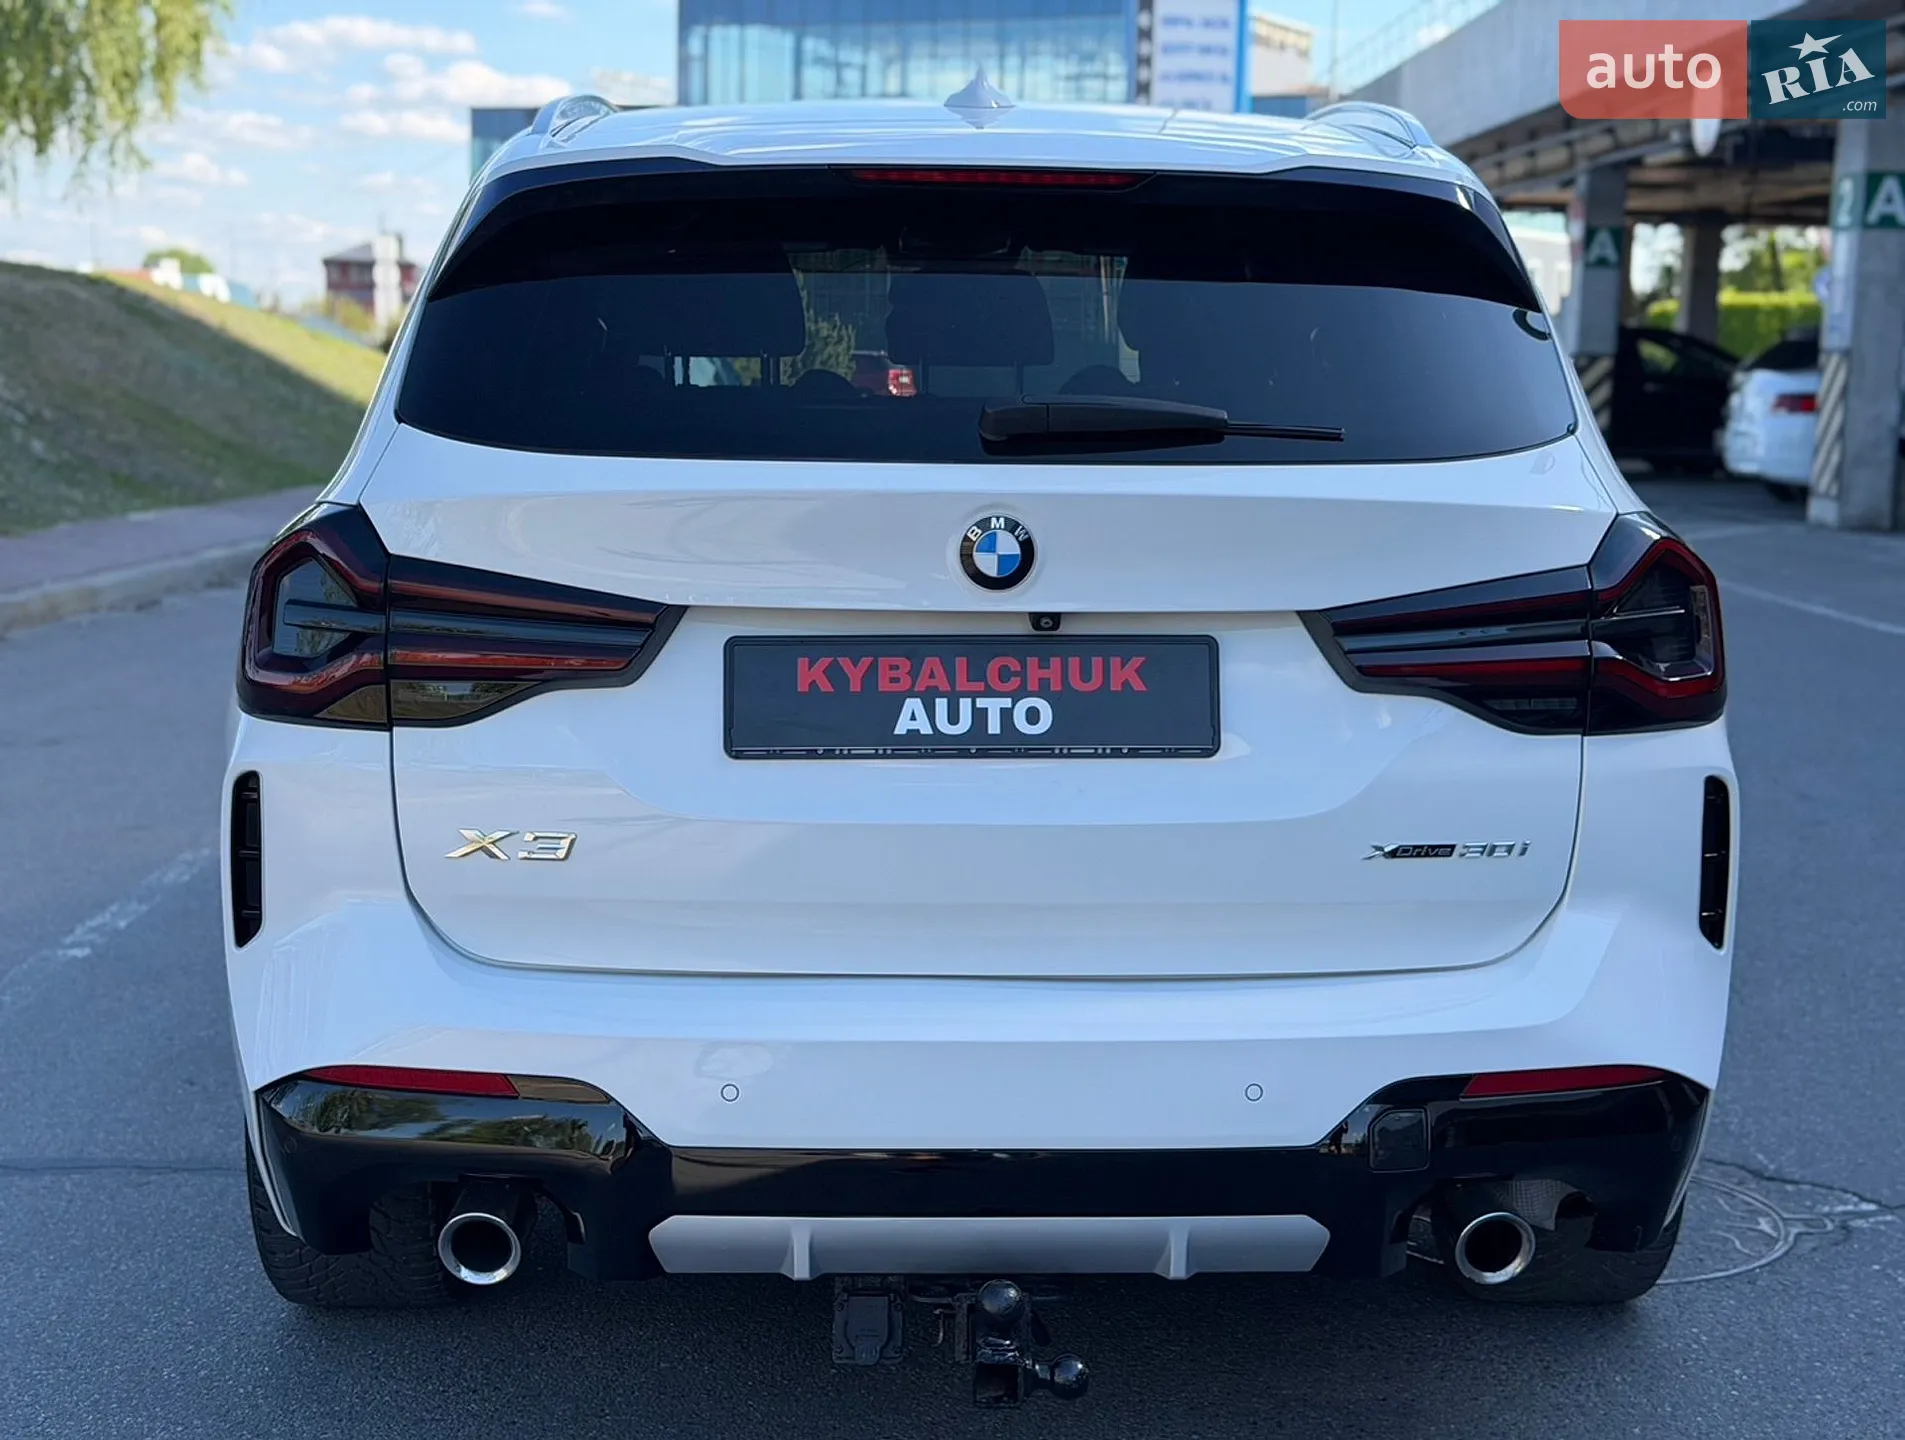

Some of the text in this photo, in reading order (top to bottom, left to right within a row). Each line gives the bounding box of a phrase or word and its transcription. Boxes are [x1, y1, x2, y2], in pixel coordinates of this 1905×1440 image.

[1867, 174, 1905, 225] A
[1589, 229, 1619, 263] A
[967, 517, 1028, 541] BMW
[797, 657, 1147, 692] KYBALCHUK
[893, 697, 1053, 735] AUTO
[444, 828, 577, 860] X3
